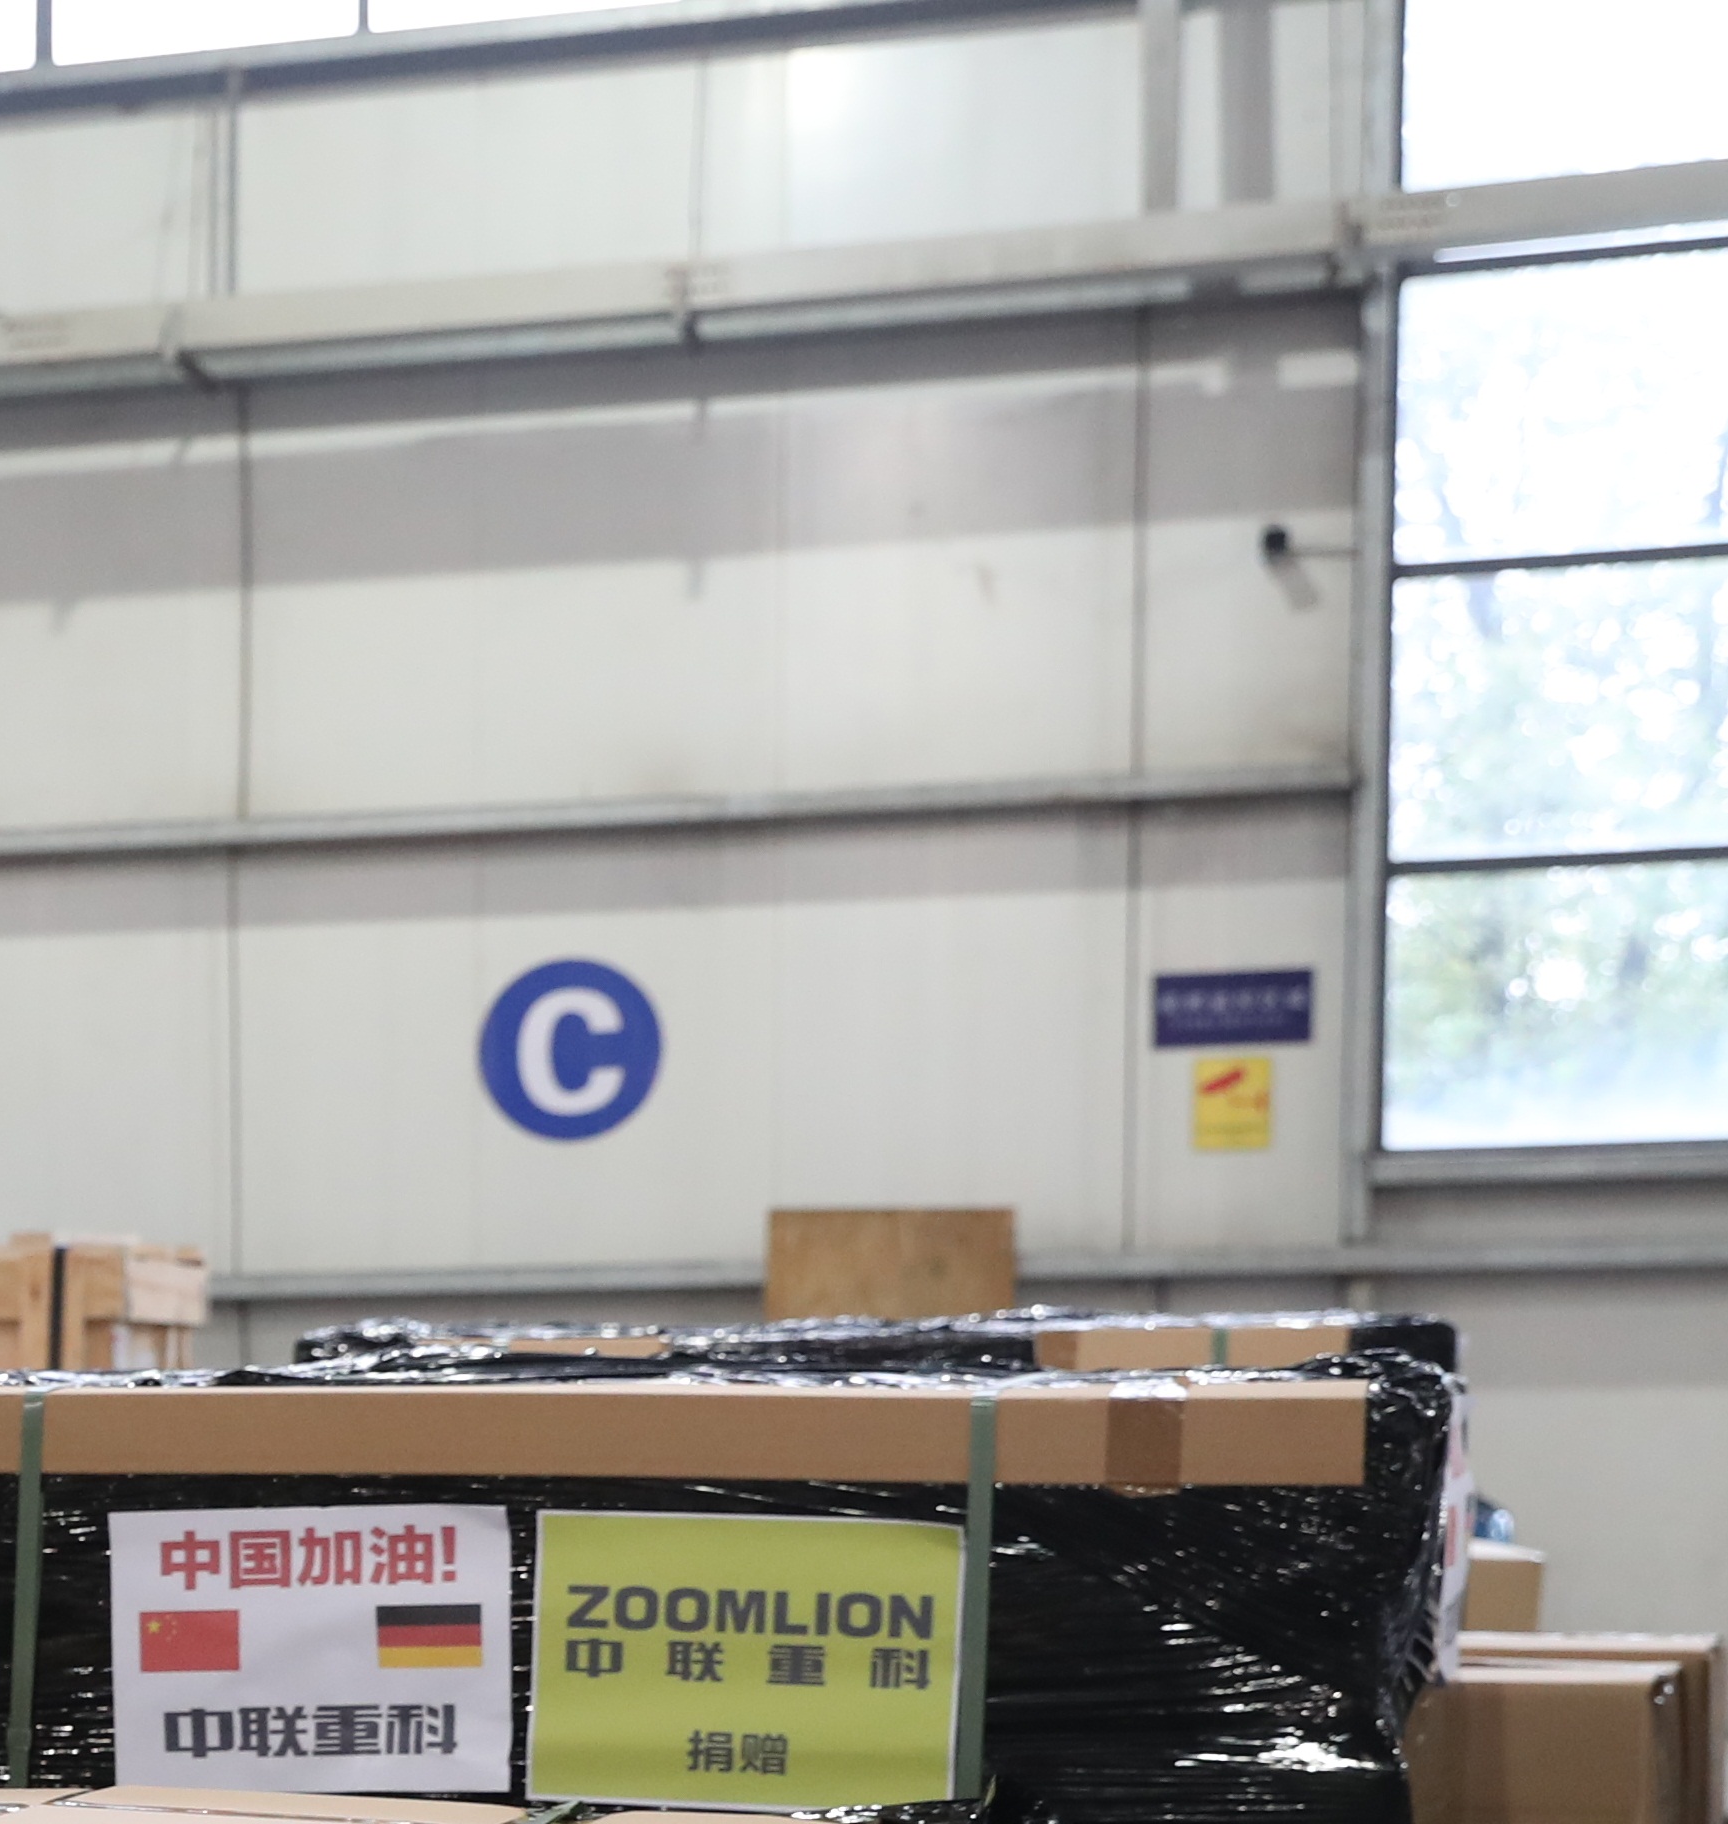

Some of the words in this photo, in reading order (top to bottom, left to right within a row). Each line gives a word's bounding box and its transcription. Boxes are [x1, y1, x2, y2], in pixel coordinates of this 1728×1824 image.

[516, 986, 625, 1117] C
[159, 1525, 456, 1591] 中国加油!
[565, 1583, 935, 1640] ZOOMLION
[564, 1638, 933, 1690] 中联重科
[163, 1702, 458, 1760] 中联重科
[687, 1729, 789, 1777] 捐赠
